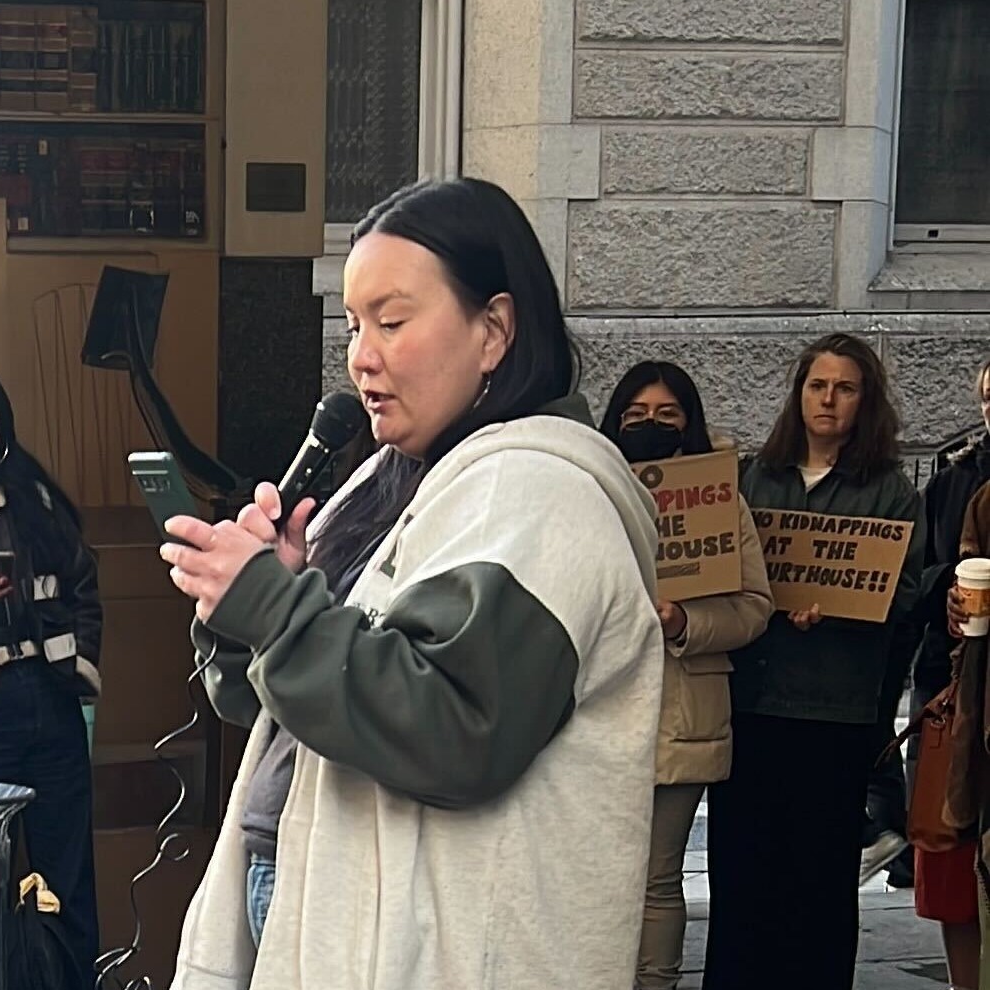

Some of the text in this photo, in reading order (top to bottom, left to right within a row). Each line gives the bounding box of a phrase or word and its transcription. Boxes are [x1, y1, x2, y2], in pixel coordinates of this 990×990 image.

[631, 464, 664, 489] O
[652, 482, 732, 514] PINGS
[779, 513, 904, 541] KIDNAPPINGS
[763, 536, 858, 560] AT THE
